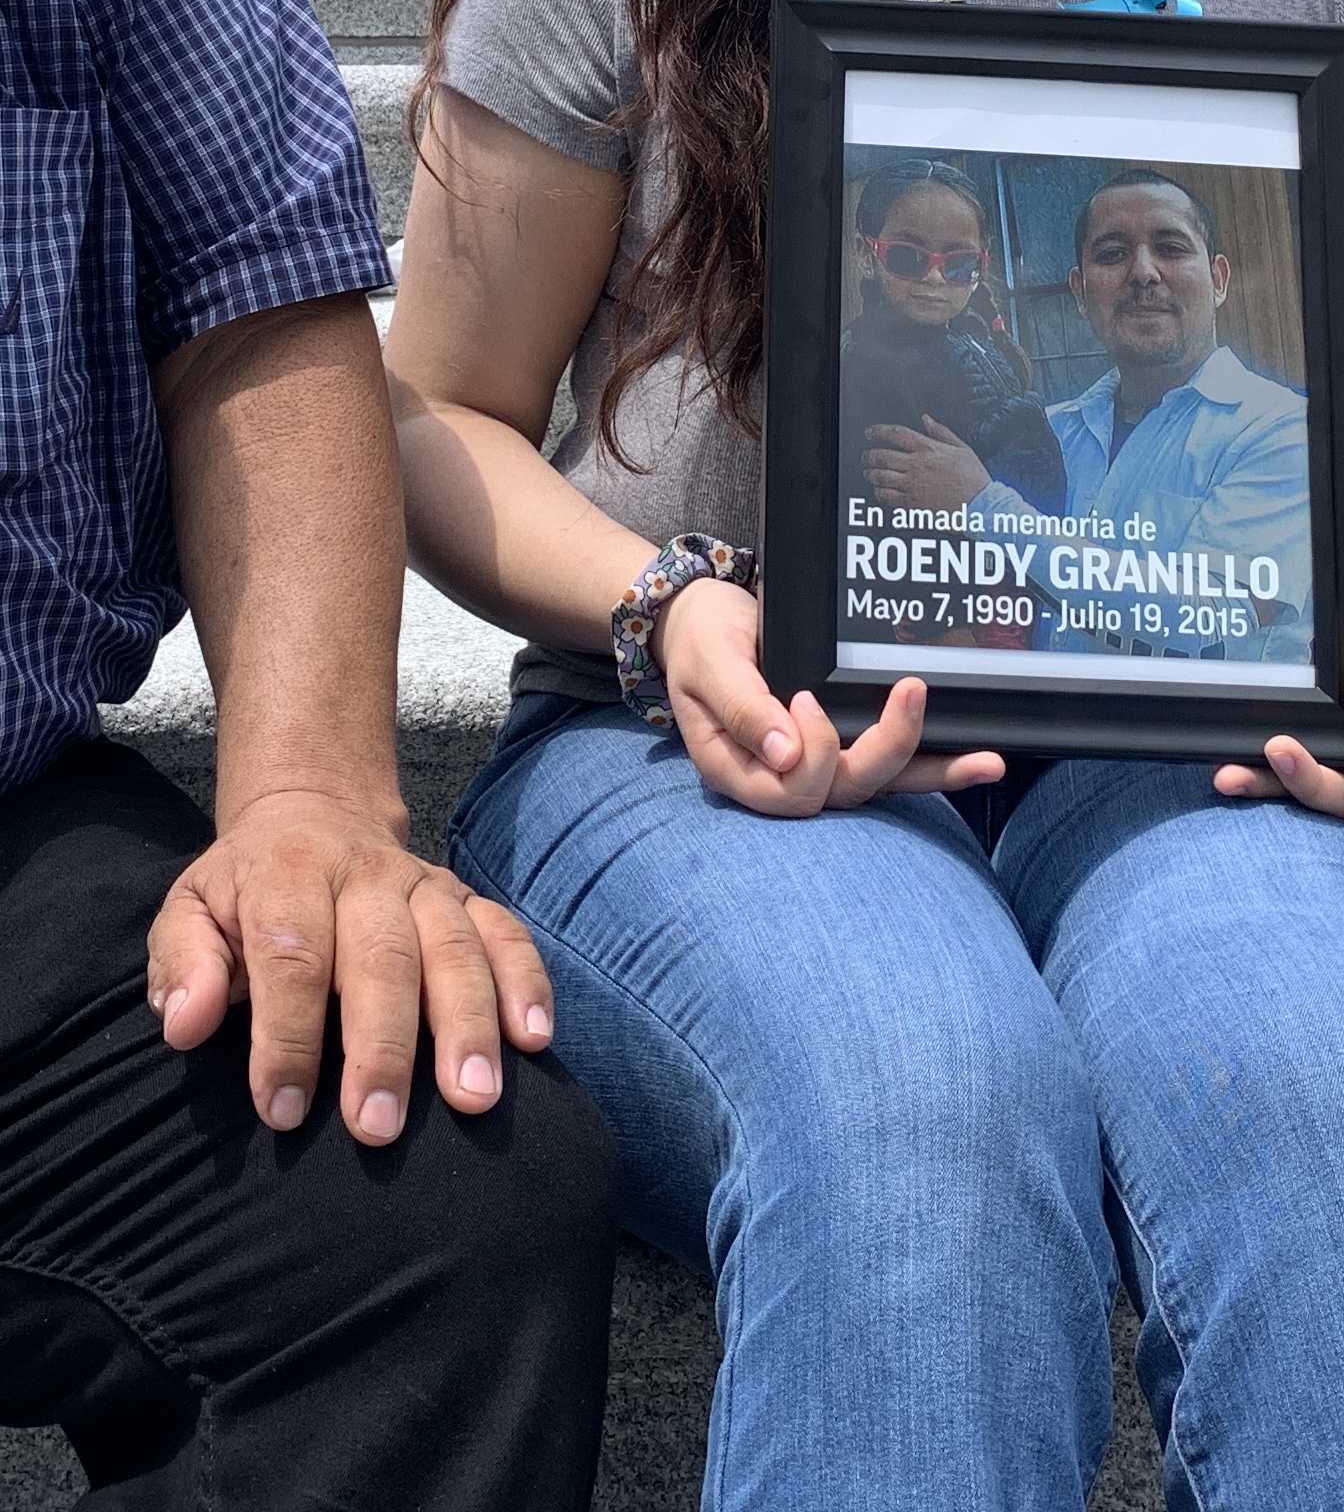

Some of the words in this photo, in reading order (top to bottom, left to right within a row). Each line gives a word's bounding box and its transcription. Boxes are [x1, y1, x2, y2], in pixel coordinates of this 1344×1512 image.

[848, 497, 884, 527] En
[891, 503, 986, 533] amada
[993, 509, 1116, 539] memoria
[1123, 511, 1157, 541] de
[846, 535, 1037, 587] ROENDY
[1049, 544, 1280, 600] GRANILLO
[846, 588, 924, 625] Mayo
[932, 592, 954, 627] 7,
[961, 594, 1034, 627] 1990
[1055, 598, 1121, 632] Julio
[1129, 602, 1170, 637] 19,
[1178, 605, 1248, 637] 2015
